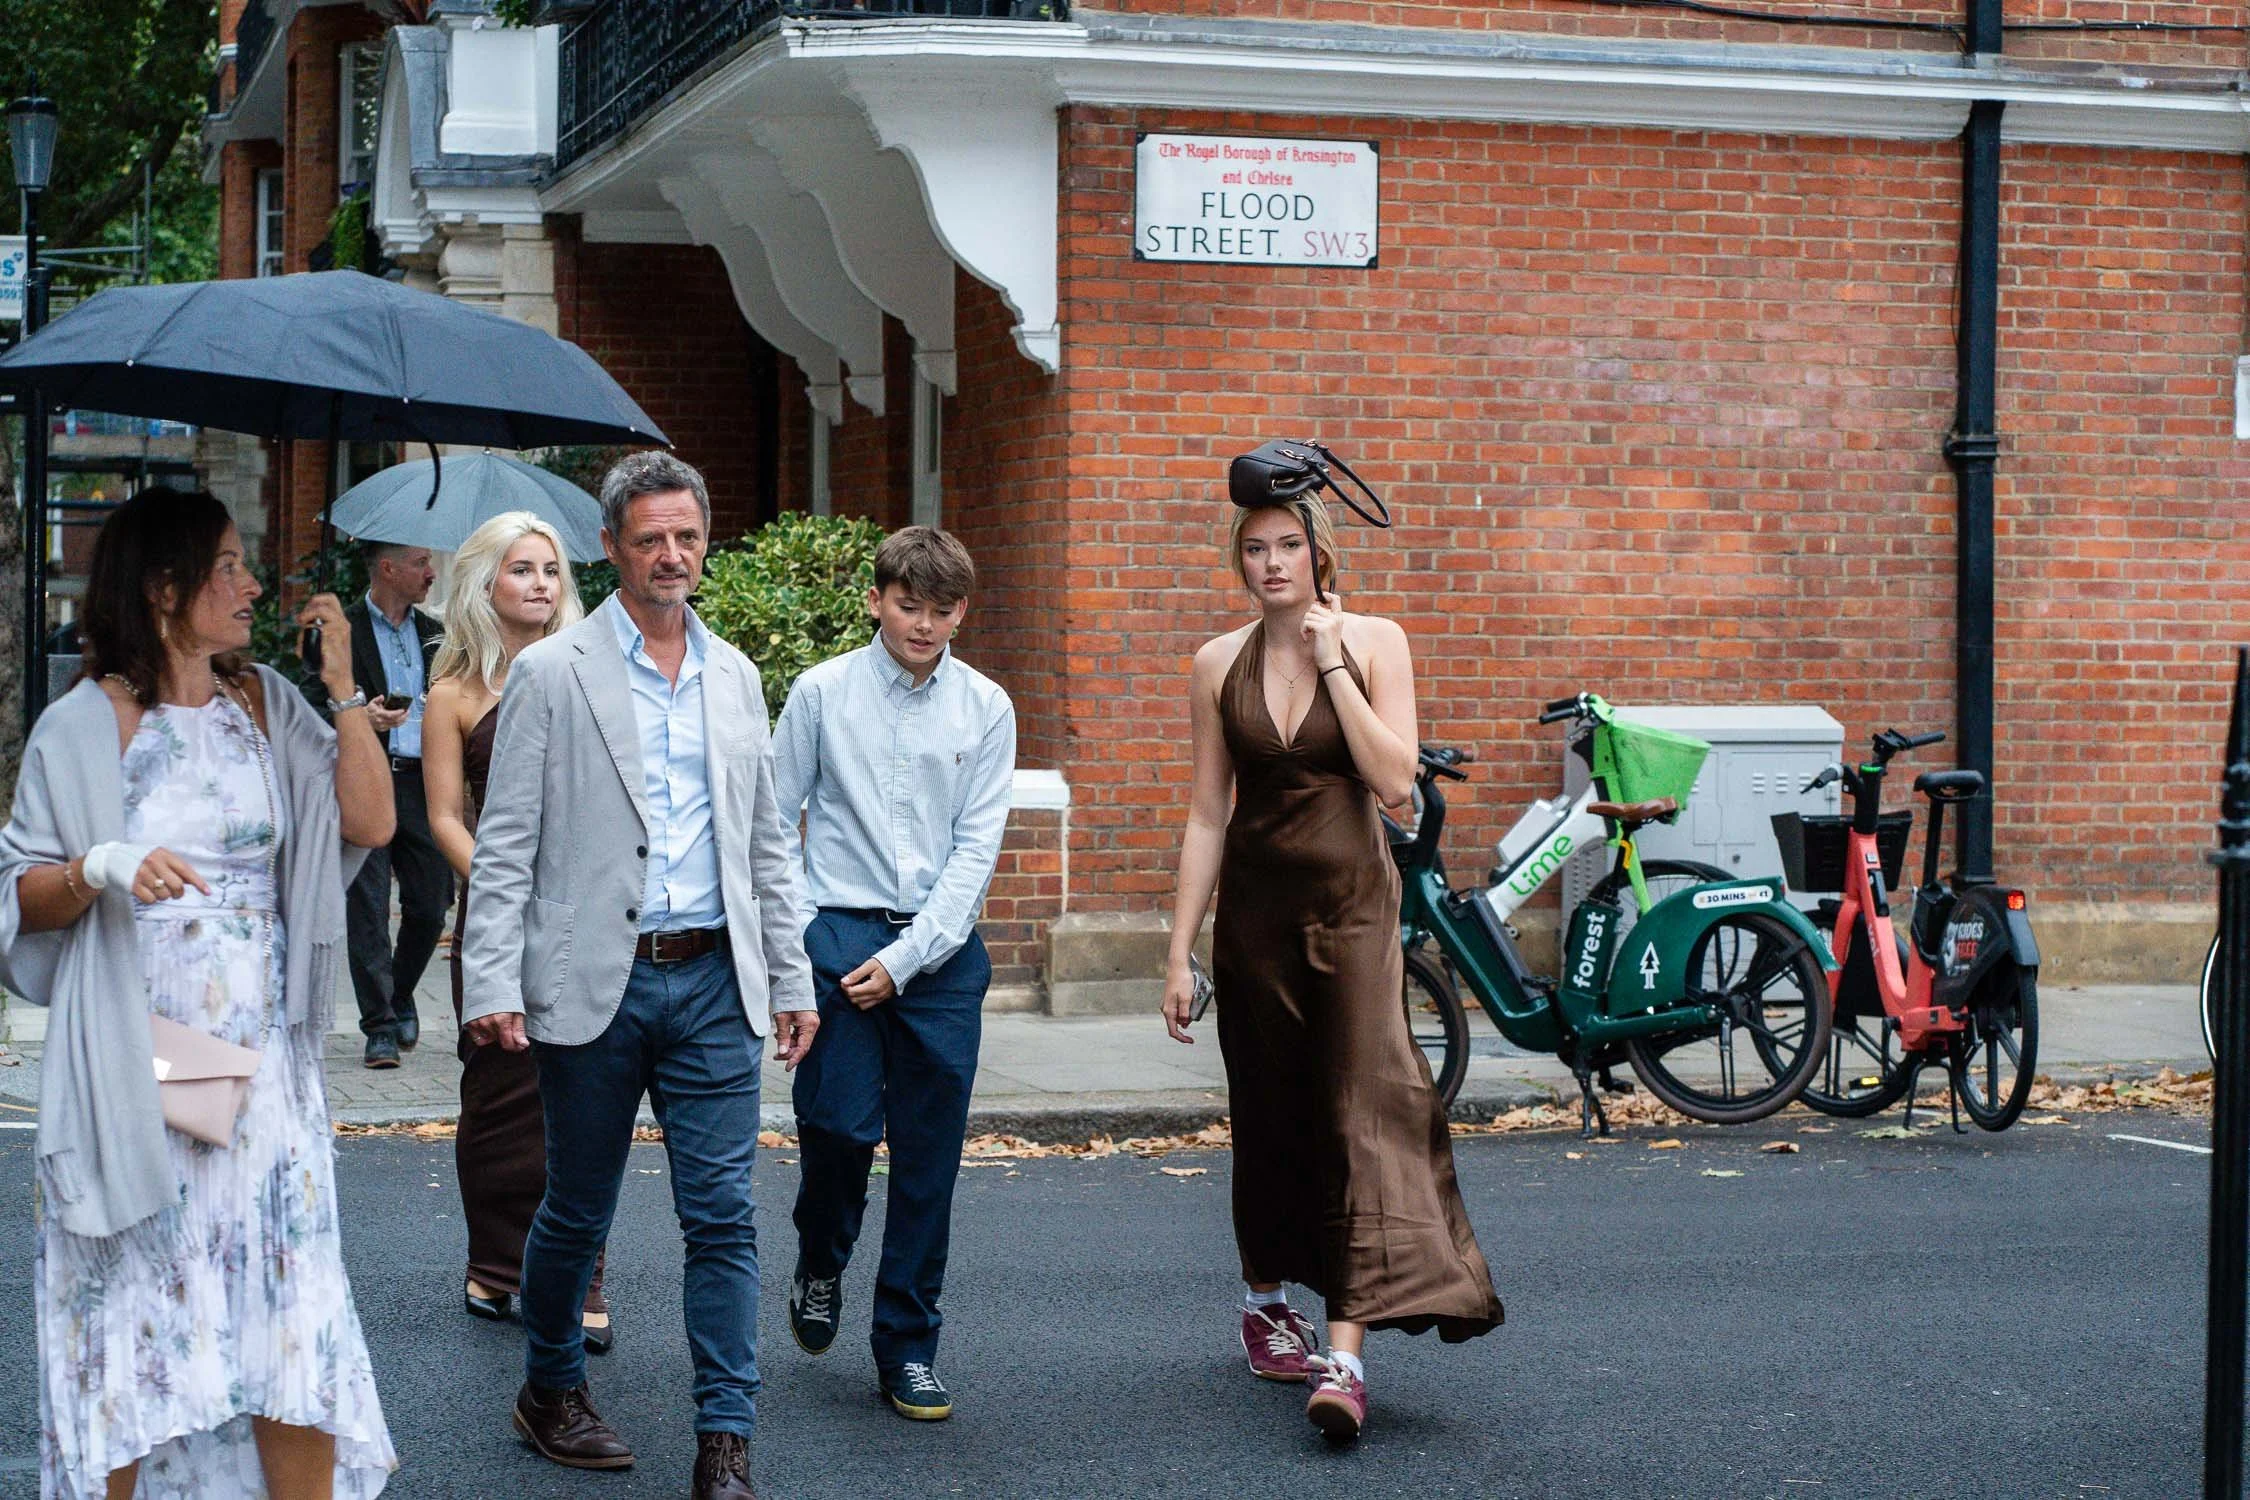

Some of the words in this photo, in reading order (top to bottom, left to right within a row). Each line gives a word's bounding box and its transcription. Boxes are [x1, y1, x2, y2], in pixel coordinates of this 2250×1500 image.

[1160, 143, 1181, 158] The
[1186, 143, 1218, 163] Royal
[1223, 144, 1272, 164] Borough
[1277, 147, 1289, 161] of
[1292, 147, 1356, 167] Kensington
[1222, 171, 1242, 184] and
[1247, 170, 1293, 186] Chelsea
[1201, 192, 1314, 221] FLOOD
[1508, 835, 1574, 897] Lime
[1721, 892, 1746, 902] MINS
[1572, 911, 1606, 988] forest
